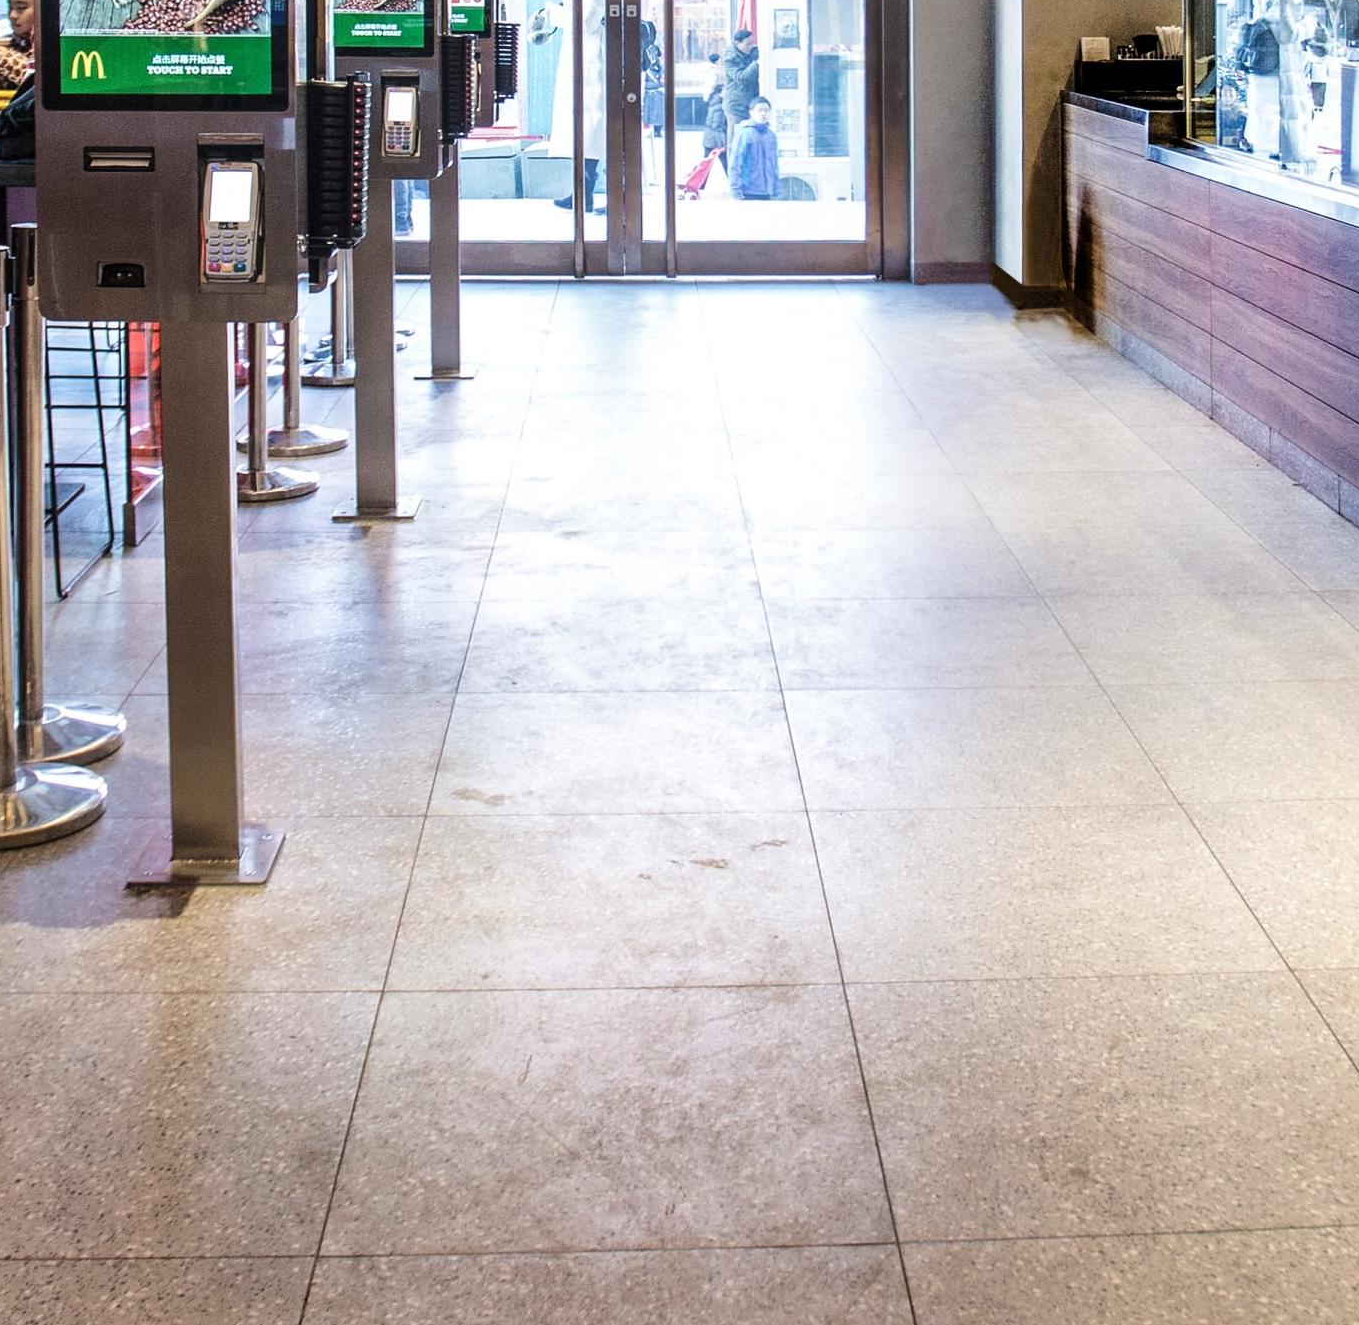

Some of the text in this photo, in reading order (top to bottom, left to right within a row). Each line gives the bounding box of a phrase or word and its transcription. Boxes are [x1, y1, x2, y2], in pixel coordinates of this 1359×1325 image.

[146, 66, 234, 75] TOUCH TO START
